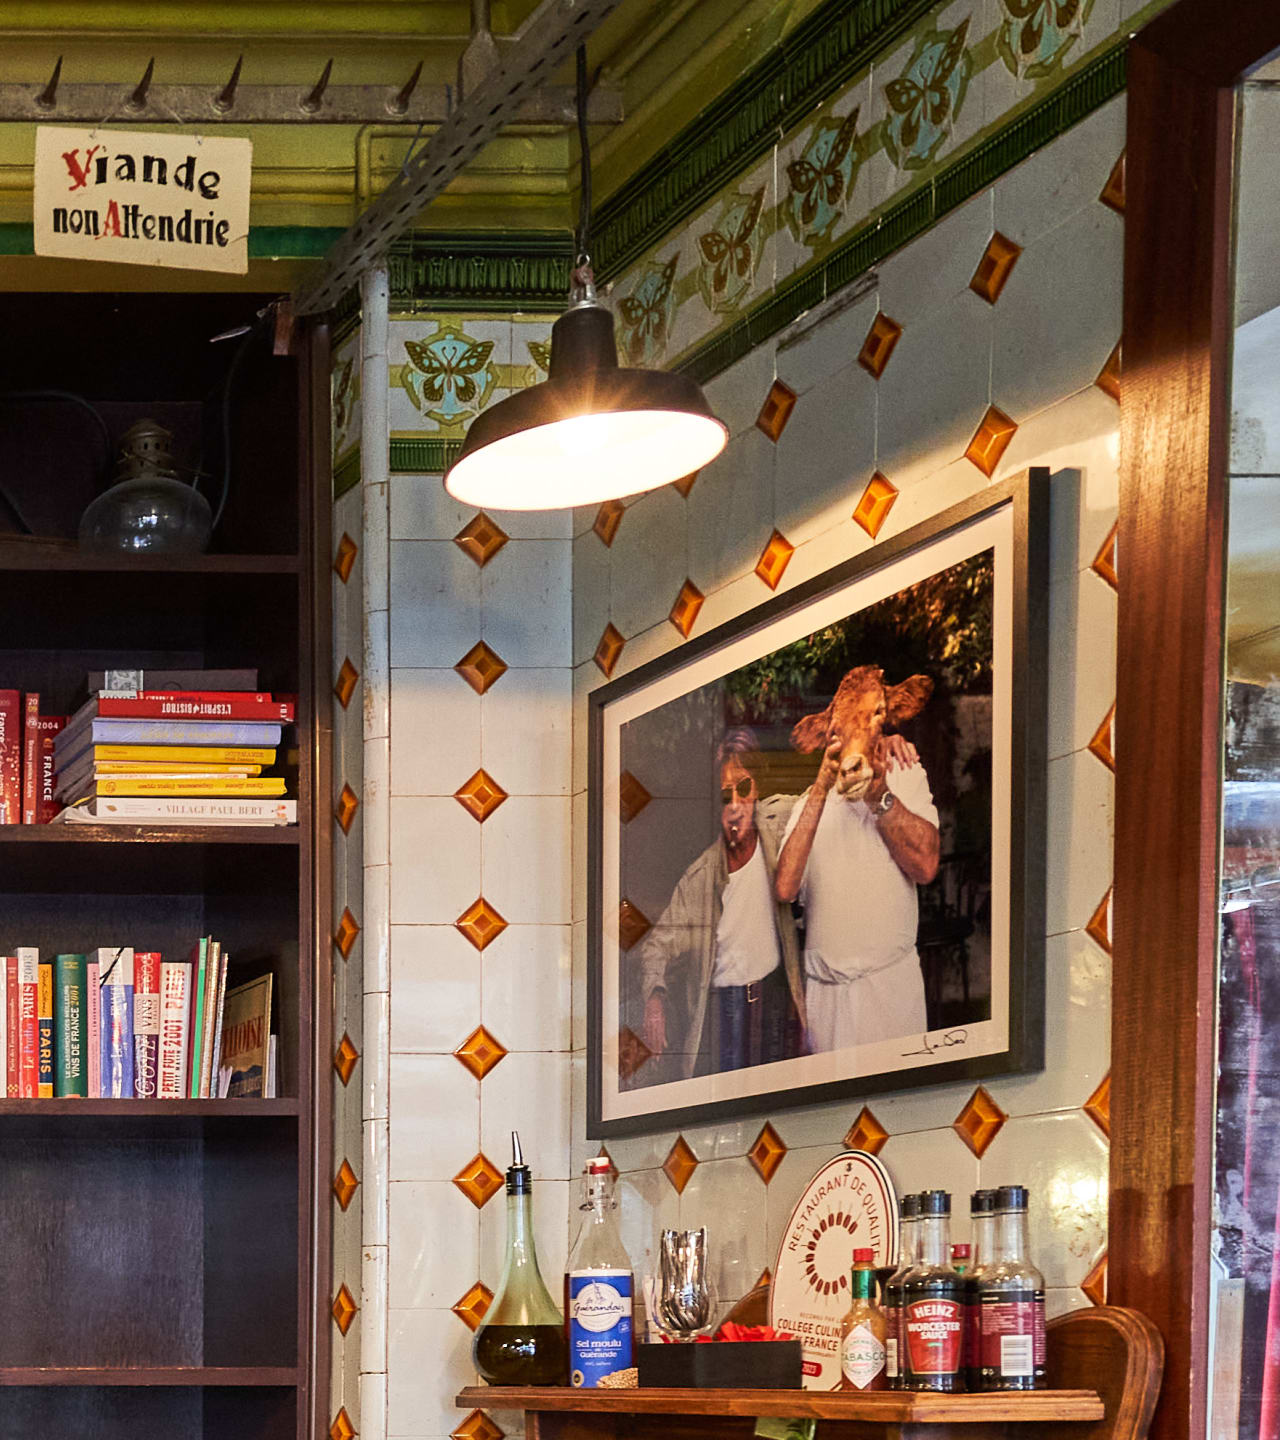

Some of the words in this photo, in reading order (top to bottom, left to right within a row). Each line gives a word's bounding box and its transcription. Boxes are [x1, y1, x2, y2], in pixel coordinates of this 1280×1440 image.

[61, 144, 221, 200] Viande
[53, 207, 100, 236] non
[94, 198, 231, 248] Attendrie
[161, 702, 193, 714] BISTROT
[37, 721, 59, 730] 2004
[43, 755, 52, 801] FRANCE
[209, 805, 235, 815] PAUL
[238, 805, 264, 815] BERT
[23, 985, 34, 1019] PARIS
[71, 1007, 81, 1042] FRANCE
[142, 999, 153, 1030] VINS
[163, 1019, 183, 1047] 2001
[40, 1028, 51, 1073] PARIS
[71, 1043, 81, 1056] DE
[162, 1049, 175, 1068] FUTE
[71, 1057, 81, 1078] VINS
[162, 1071, 175, 1093] PETIT
[788, 1174, 850, 1252] RESTAURANT
[850, 1176, 867, 1196] DE
[913, 1304, 955, 1319] HEINZ
[907, 1321, 961, 1332] WORCESTER
[920, 1331, 948, 1340] SAUCE
[576, 1340, 590, 1348] Sel
[591, 1339, 622, 1348] moulu
[804, 1335, 839, 1352] FRANCE
